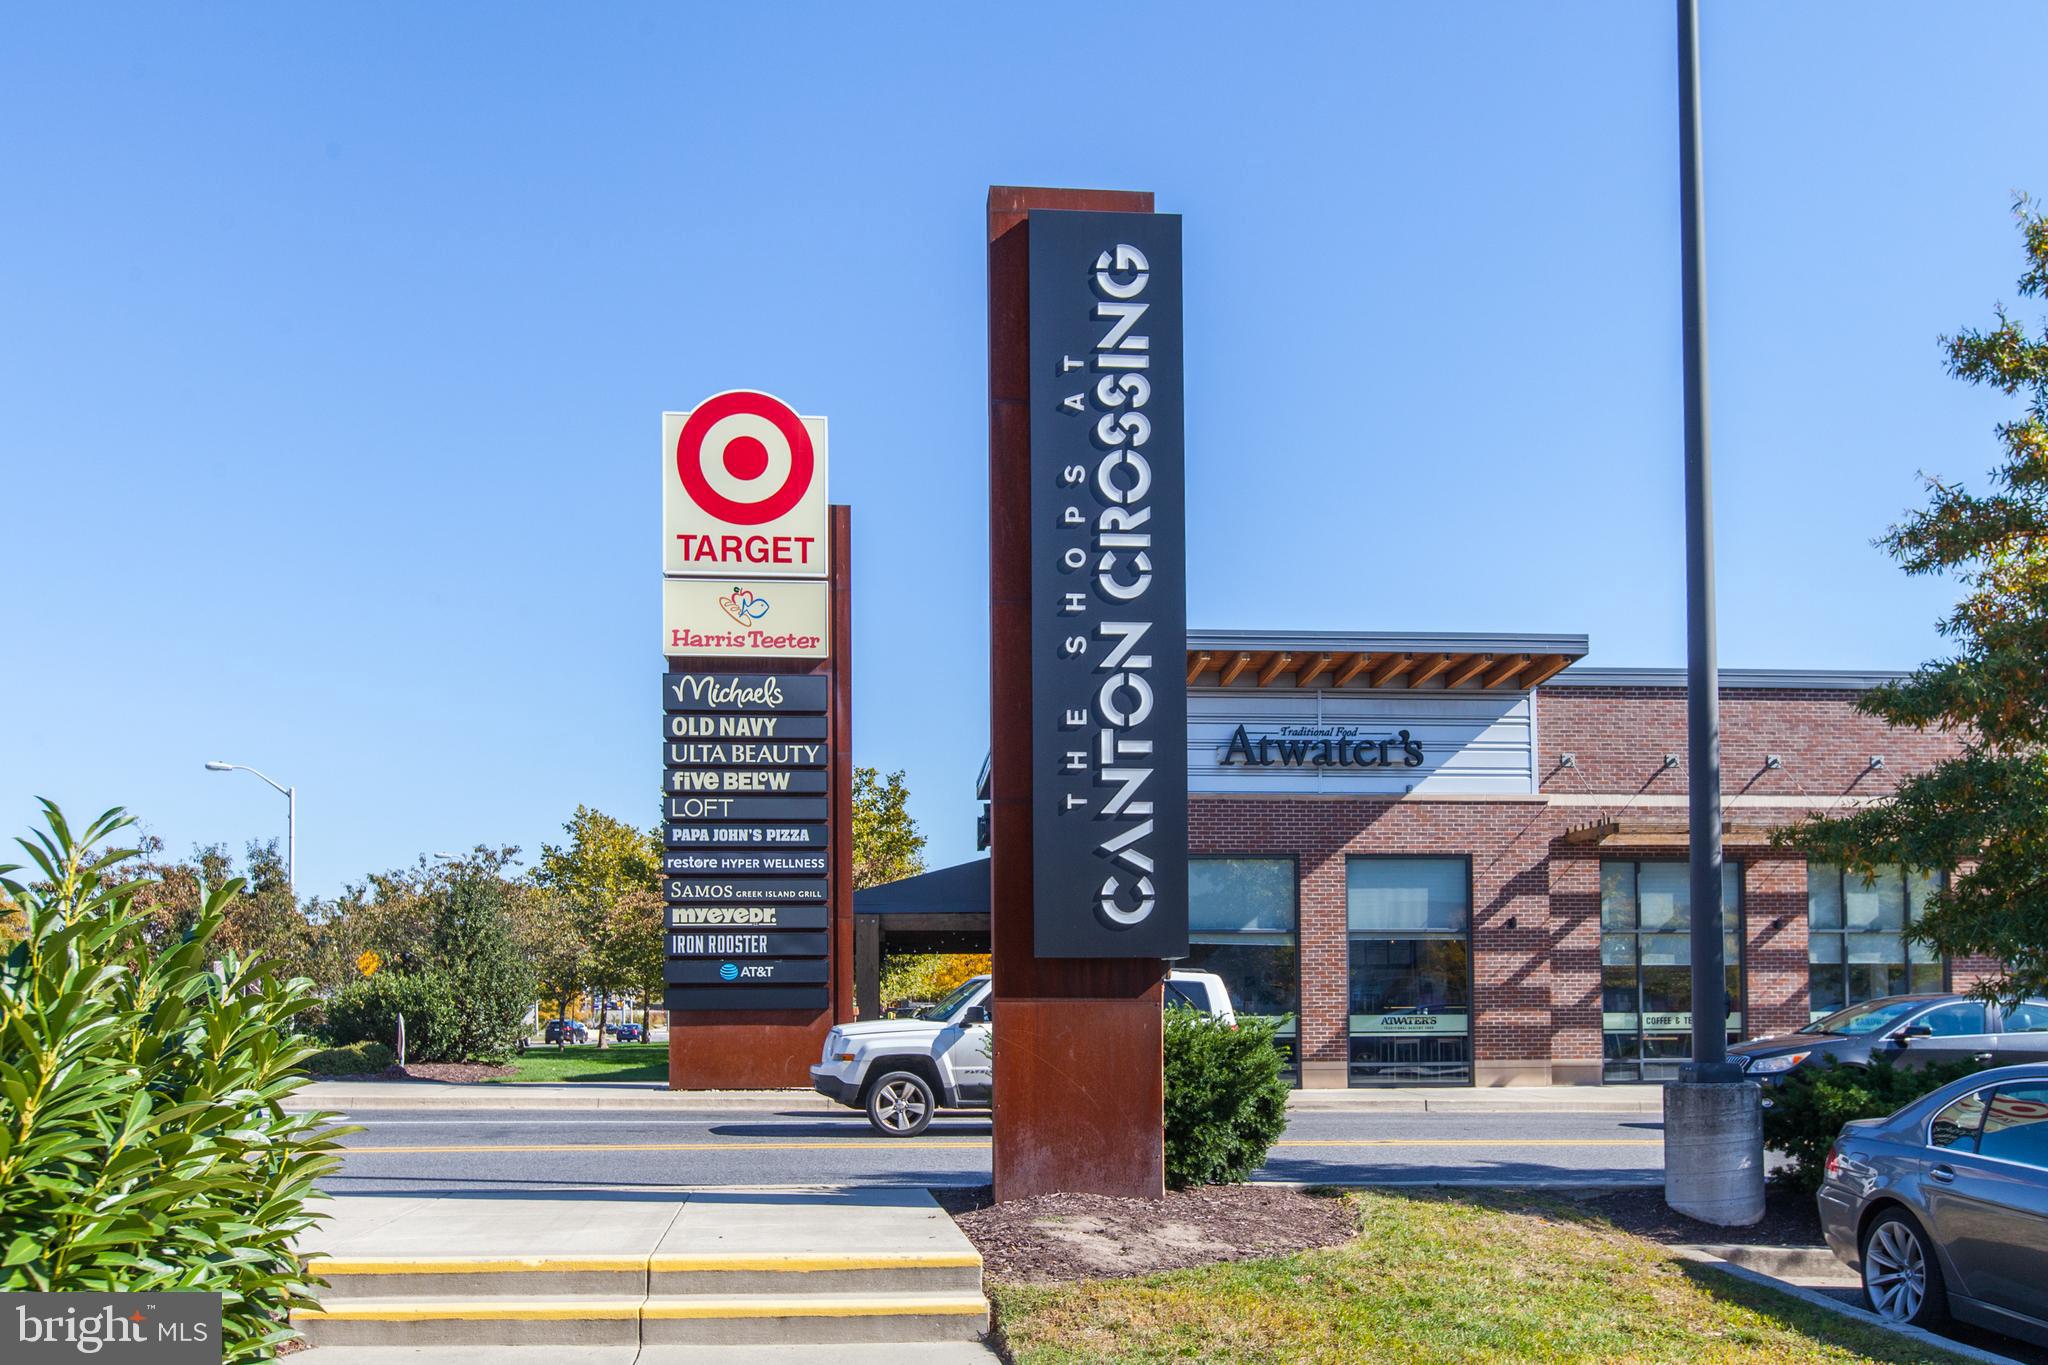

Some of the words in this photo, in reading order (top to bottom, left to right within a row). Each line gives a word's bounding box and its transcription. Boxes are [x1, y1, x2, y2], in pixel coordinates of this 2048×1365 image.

[1063, 355, 1085, 411] AT
[1096, 243, 1153, 599] CROSSING
[676, 534, 815, 564] TARGET
[1064, 464, 1087, 654] SHOPS
[671, 629, 746, 648] Harris
[747, 630, 821, 649] Teeter
[672, 674, 784, 709] Michaels
[672, 716, 715, 736] OLD
[719, 717, 778, 737] NAVY
[1280, 726, 1334, 737] Traditional
[1335, 727, 1359, 738] Food
[671, 744, 727, 763] ULTA
[731, 744, 820, 764] BEAUTY
[1219, 723, 1425, 768] Atwater's
[1066, 708, 1088, 809] THE
[672, 771, 720, 790] five
[723, 772, 791, 791] BELOW
[1098, 621, 1155, 925] CANTON
[672, 798, 734, 817] LOFT
[672, 828, 710, 842] PAPA
[712, 828, 763, 842] JOHN'S
[766, 829, 810, 842] PIZZA
[667, 856, 718, 869] restore
[721, 859, 760, 869] HYPER
[763, 859, 825, 869] WELLNESS
[671, 881, 733, 898] SAMOS
[736, 890, 763, 898] GREEK
[765, 890, 796, 898] ISLAND
[672, 935, 704, 953] IRON
[708, 935, 768, 953] ROOSTER
[740, 966, 774, 978] AT&T
[1381, 1016, 1437, 1025] ATWATER'S
[1646, 1016, 1672, 1025] COFFEE
